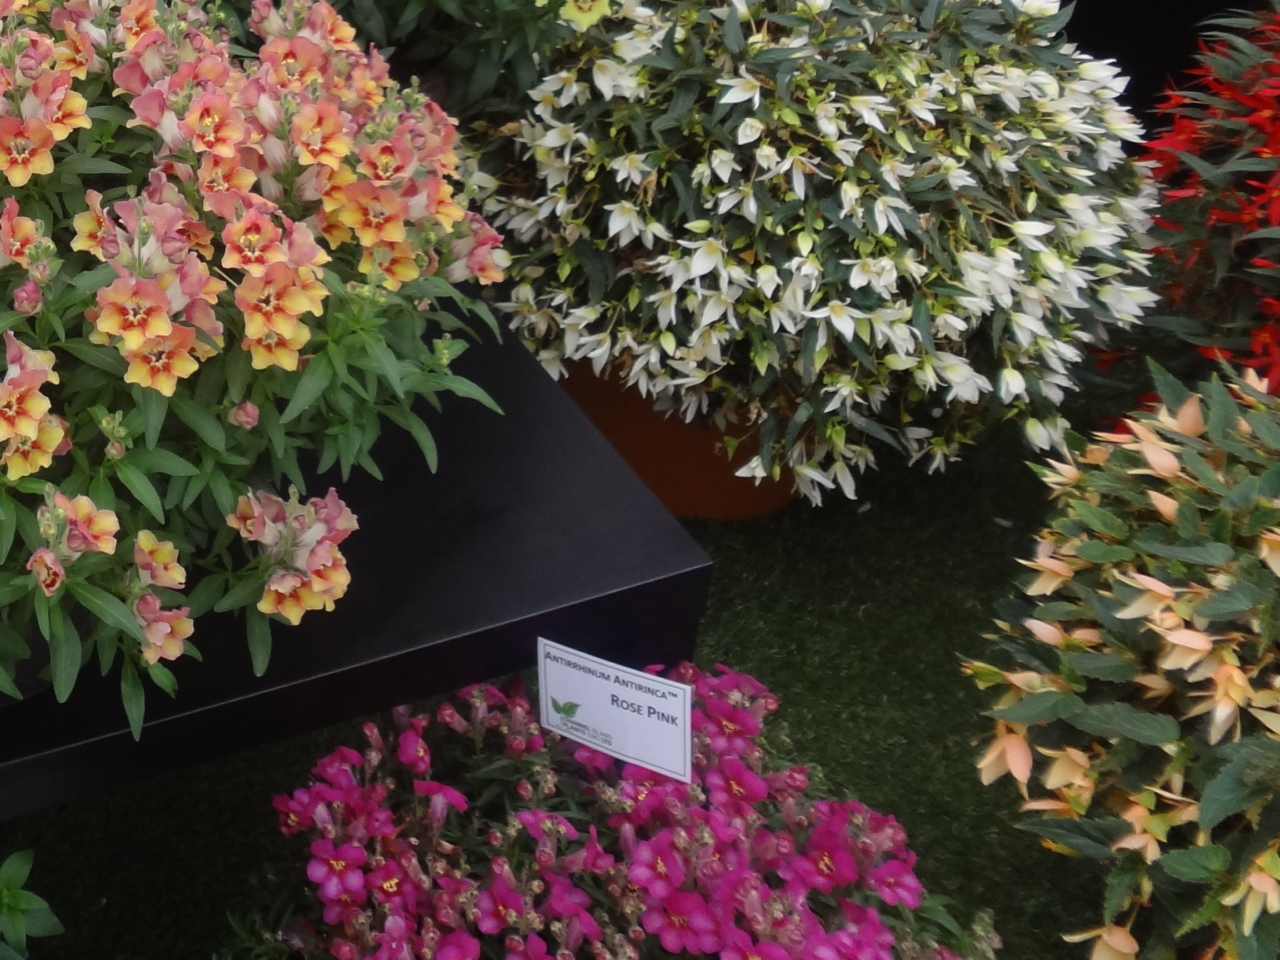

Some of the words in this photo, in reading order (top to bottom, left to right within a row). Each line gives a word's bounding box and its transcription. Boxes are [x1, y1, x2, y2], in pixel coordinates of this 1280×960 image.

[544, 651, 612, 683] ANTIRRHINUM
[610, 693, 645, 717] ROSE
[647, 706, 679, 727] PINK
